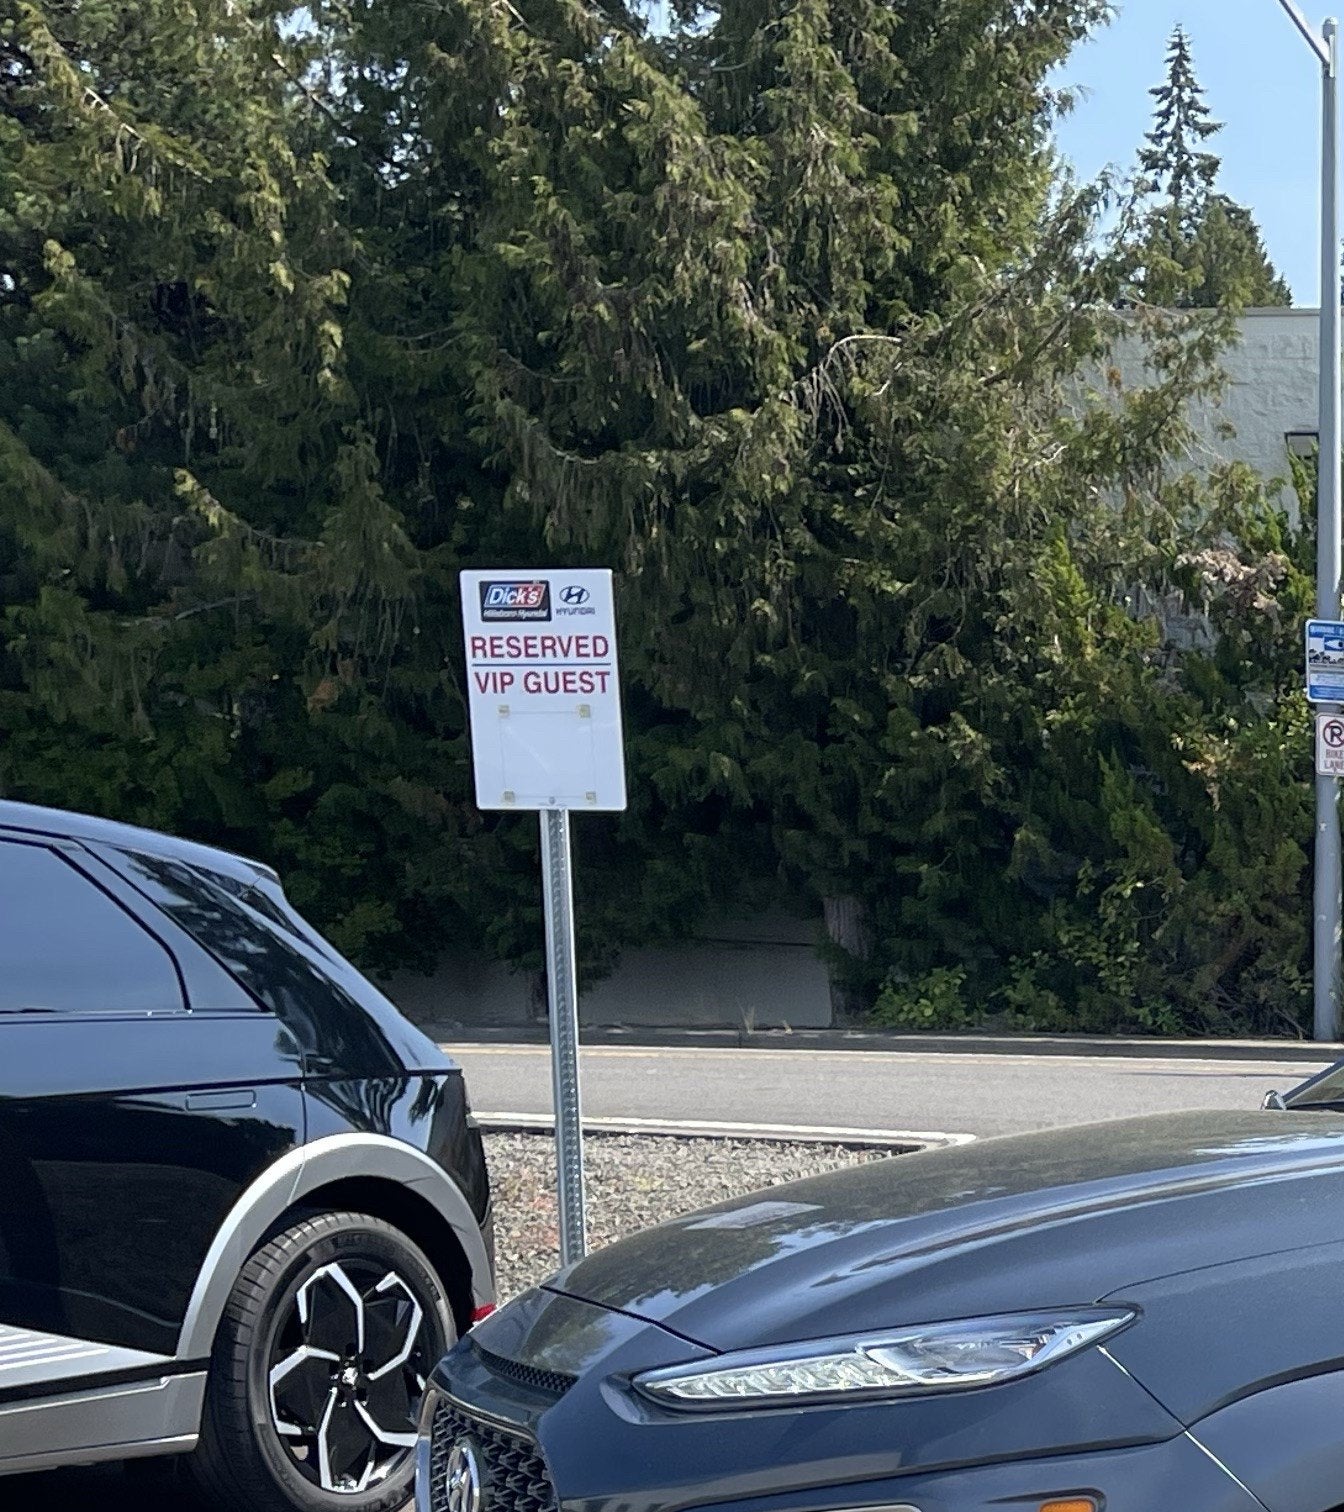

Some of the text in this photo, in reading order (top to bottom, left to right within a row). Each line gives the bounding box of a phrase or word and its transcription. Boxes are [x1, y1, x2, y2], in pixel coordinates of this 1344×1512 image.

[489, 587, 538, 605] Dick's
[471, 635, 609, 659] RESERVED
[474, 671, 611, 695] VIP GUEST
